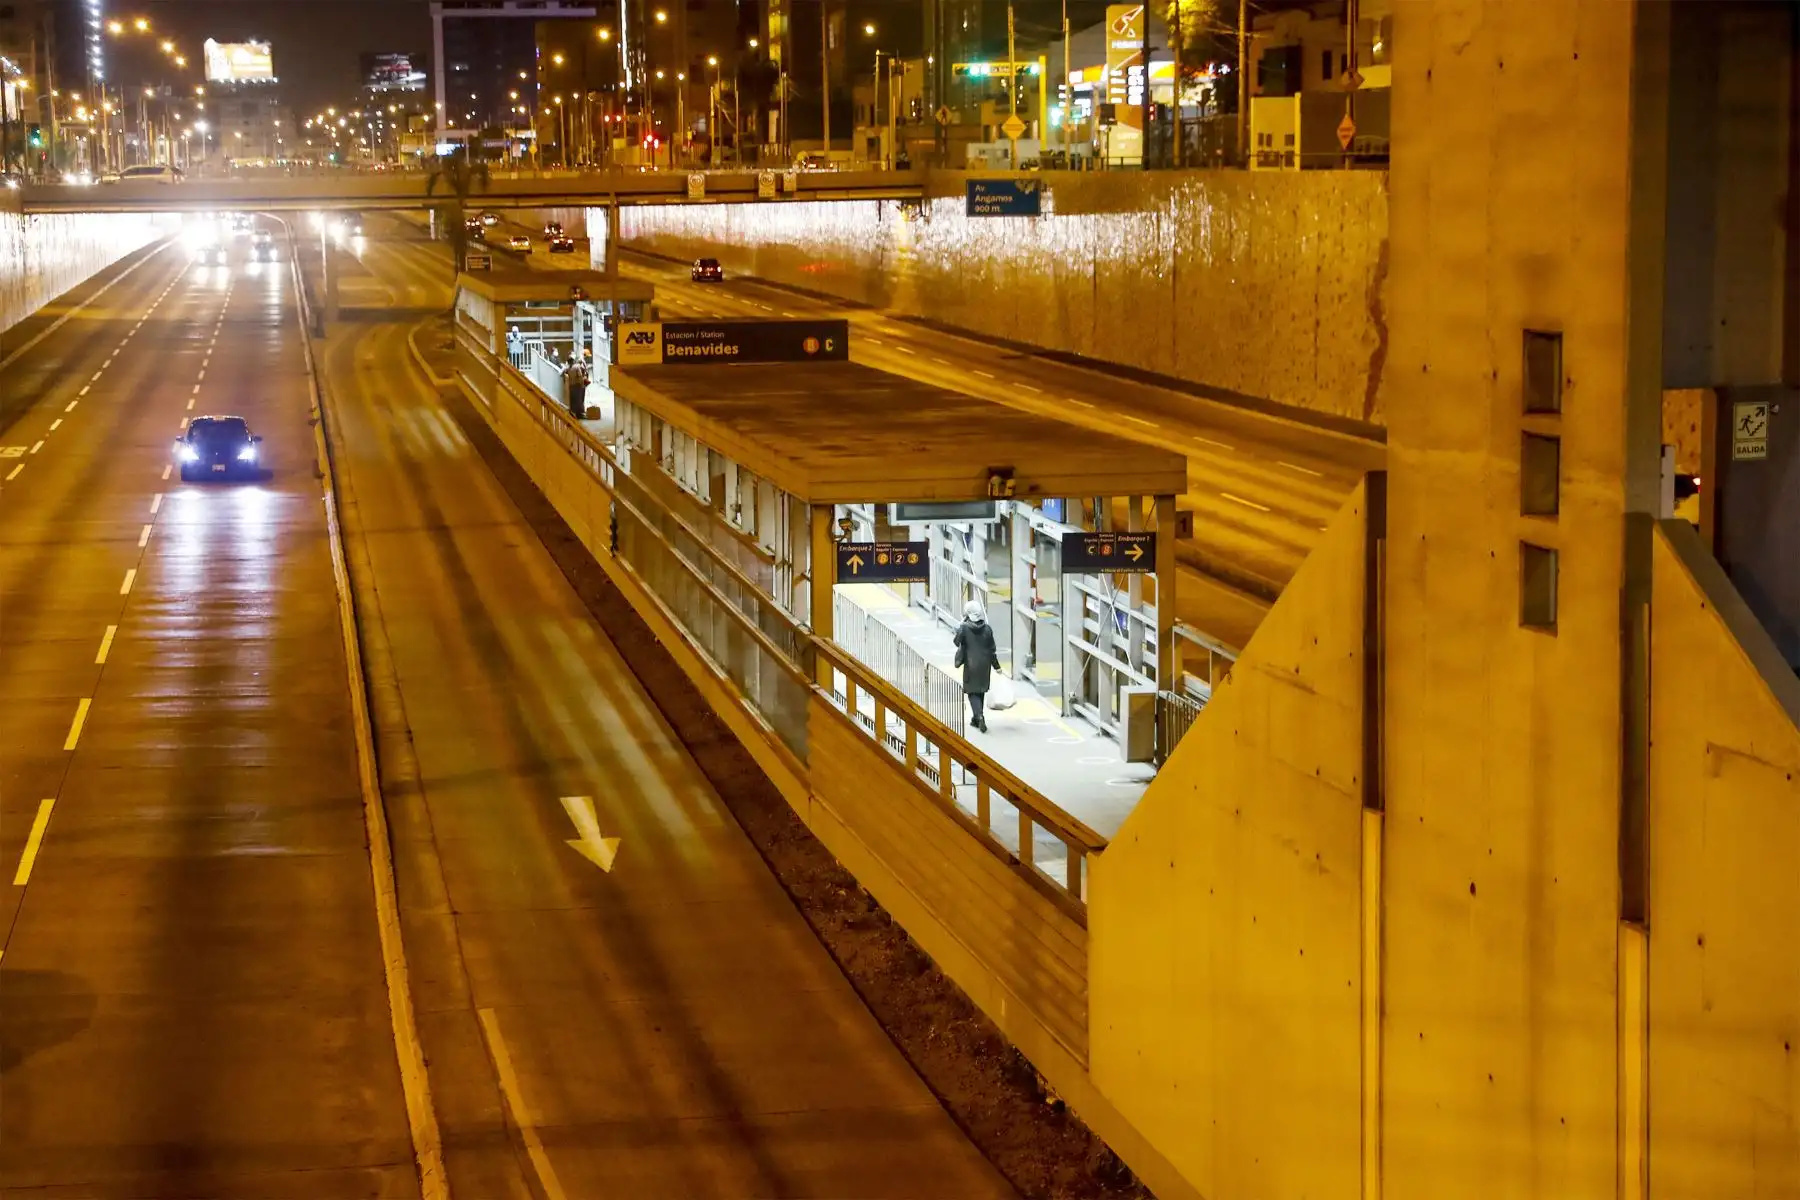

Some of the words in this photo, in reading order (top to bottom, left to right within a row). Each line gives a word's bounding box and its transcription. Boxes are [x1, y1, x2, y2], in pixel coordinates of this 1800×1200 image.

[975, 195, 1013, 204] Angamos
[974, 205, 990, 213] 900
[625, 331, 656, 344] ATU
[700, 330, 725, 339] Station
[666, 342, 739, 356] Benavides
[825, 338, 834, 352] C
[1736, 446, 1765, 454] SALIDA
[1118, 535, 1146, 543] Embarque
[839, 545, 868, 553] Embarque
[1088, 546, 1095, 554] C
[895, 554, 902, 563] 2
